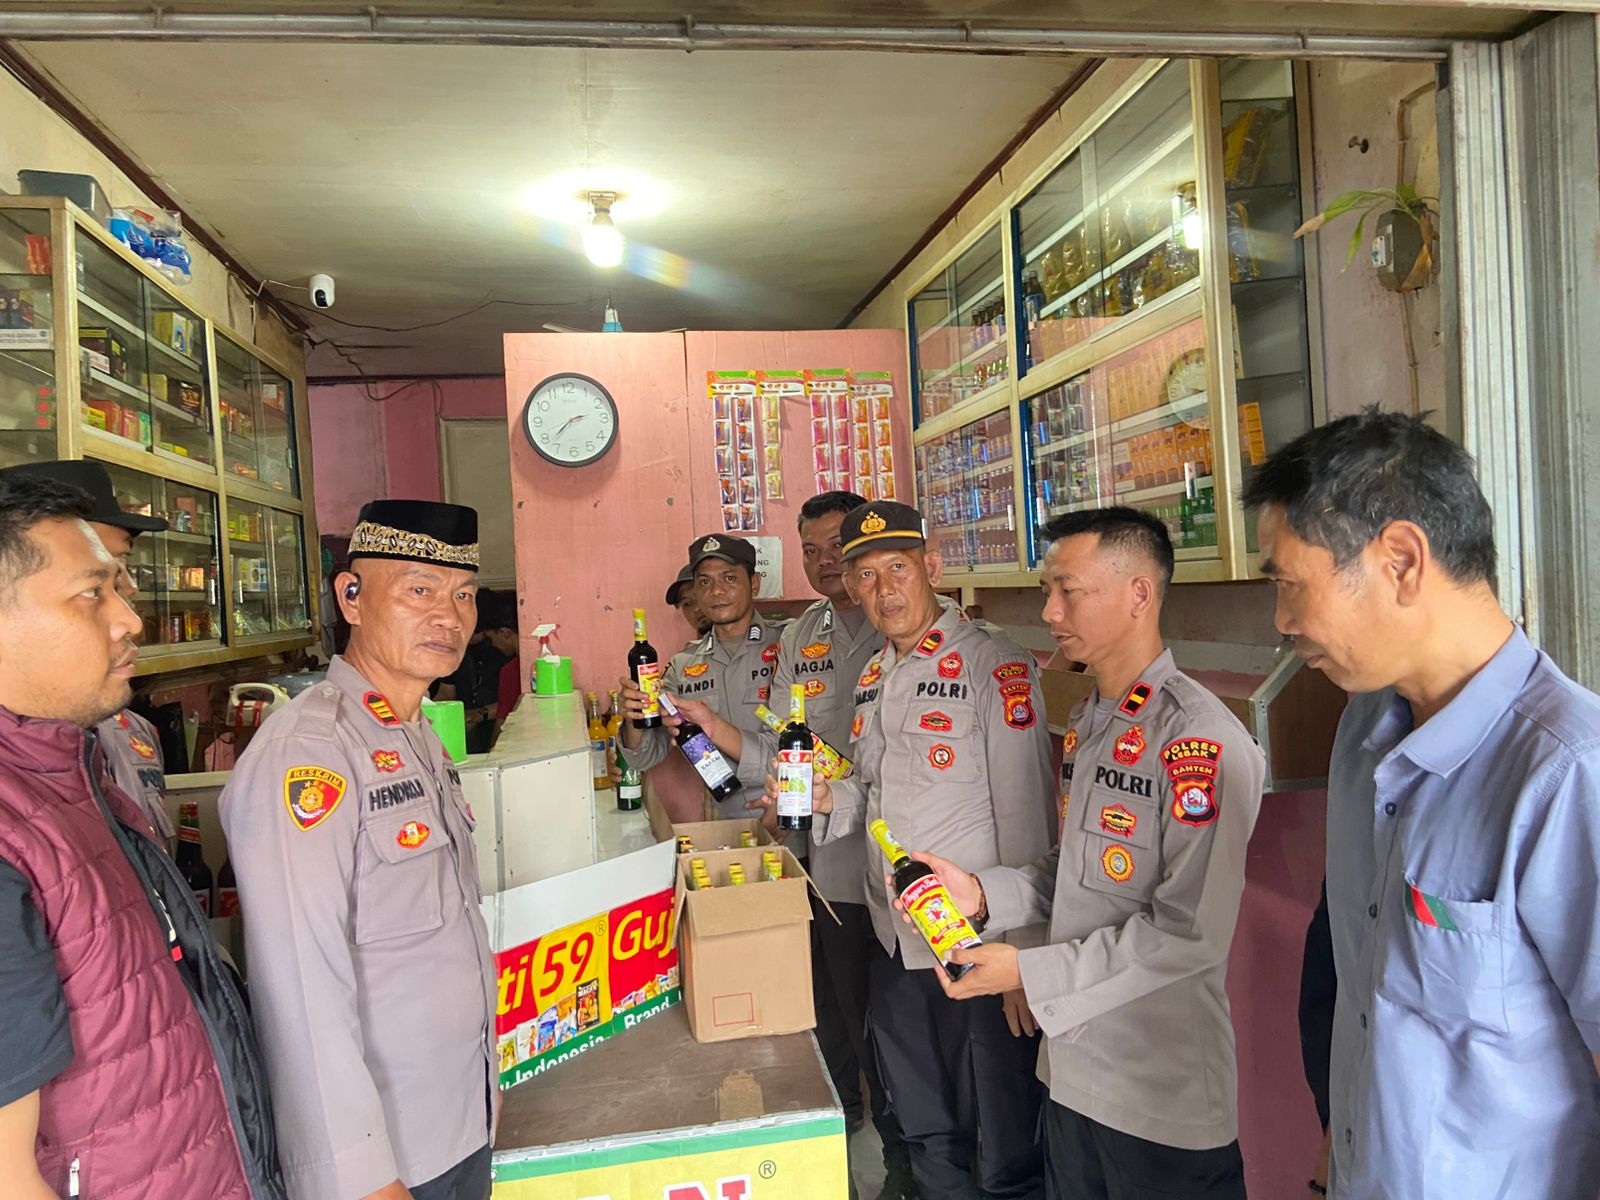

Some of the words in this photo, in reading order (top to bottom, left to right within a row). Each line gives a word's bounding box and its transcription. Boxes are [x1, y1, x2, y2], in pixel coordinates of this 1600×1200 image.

[547, 388, 557, 400] 11
[561, 382, 575, 394] 12
[583, 386, 588, 398] 1
[536, 400, 551, 412] 10
[593, 397, 603, 409] 2
[533, 416, 543, 428] 9
[599, 412, 609, 424] 3
[540, 433, 551, 444] 8
[596, 429, 608, 441] 4
[552, 442, 560, 454] 7
[569, 446, 579, 457] 6
[585, 441, 595, 452] 5
[677, 678, 714, 695] HANDI
[917, 682, 968, 700] POLRI
[1163, 741, 1218, 759] POLRES
[1172, 749, 1209, 761] LEBAK
[1172, 765, 1214, 776] BANTEN
[293, 769, 341, 786] RESKRIM
[1095, 765, 1152, 797] POLRI
[496, 954, 530, 1015] ti
[540, 931, 594, 998] 59
[612, 897, 676, 961] Guj
